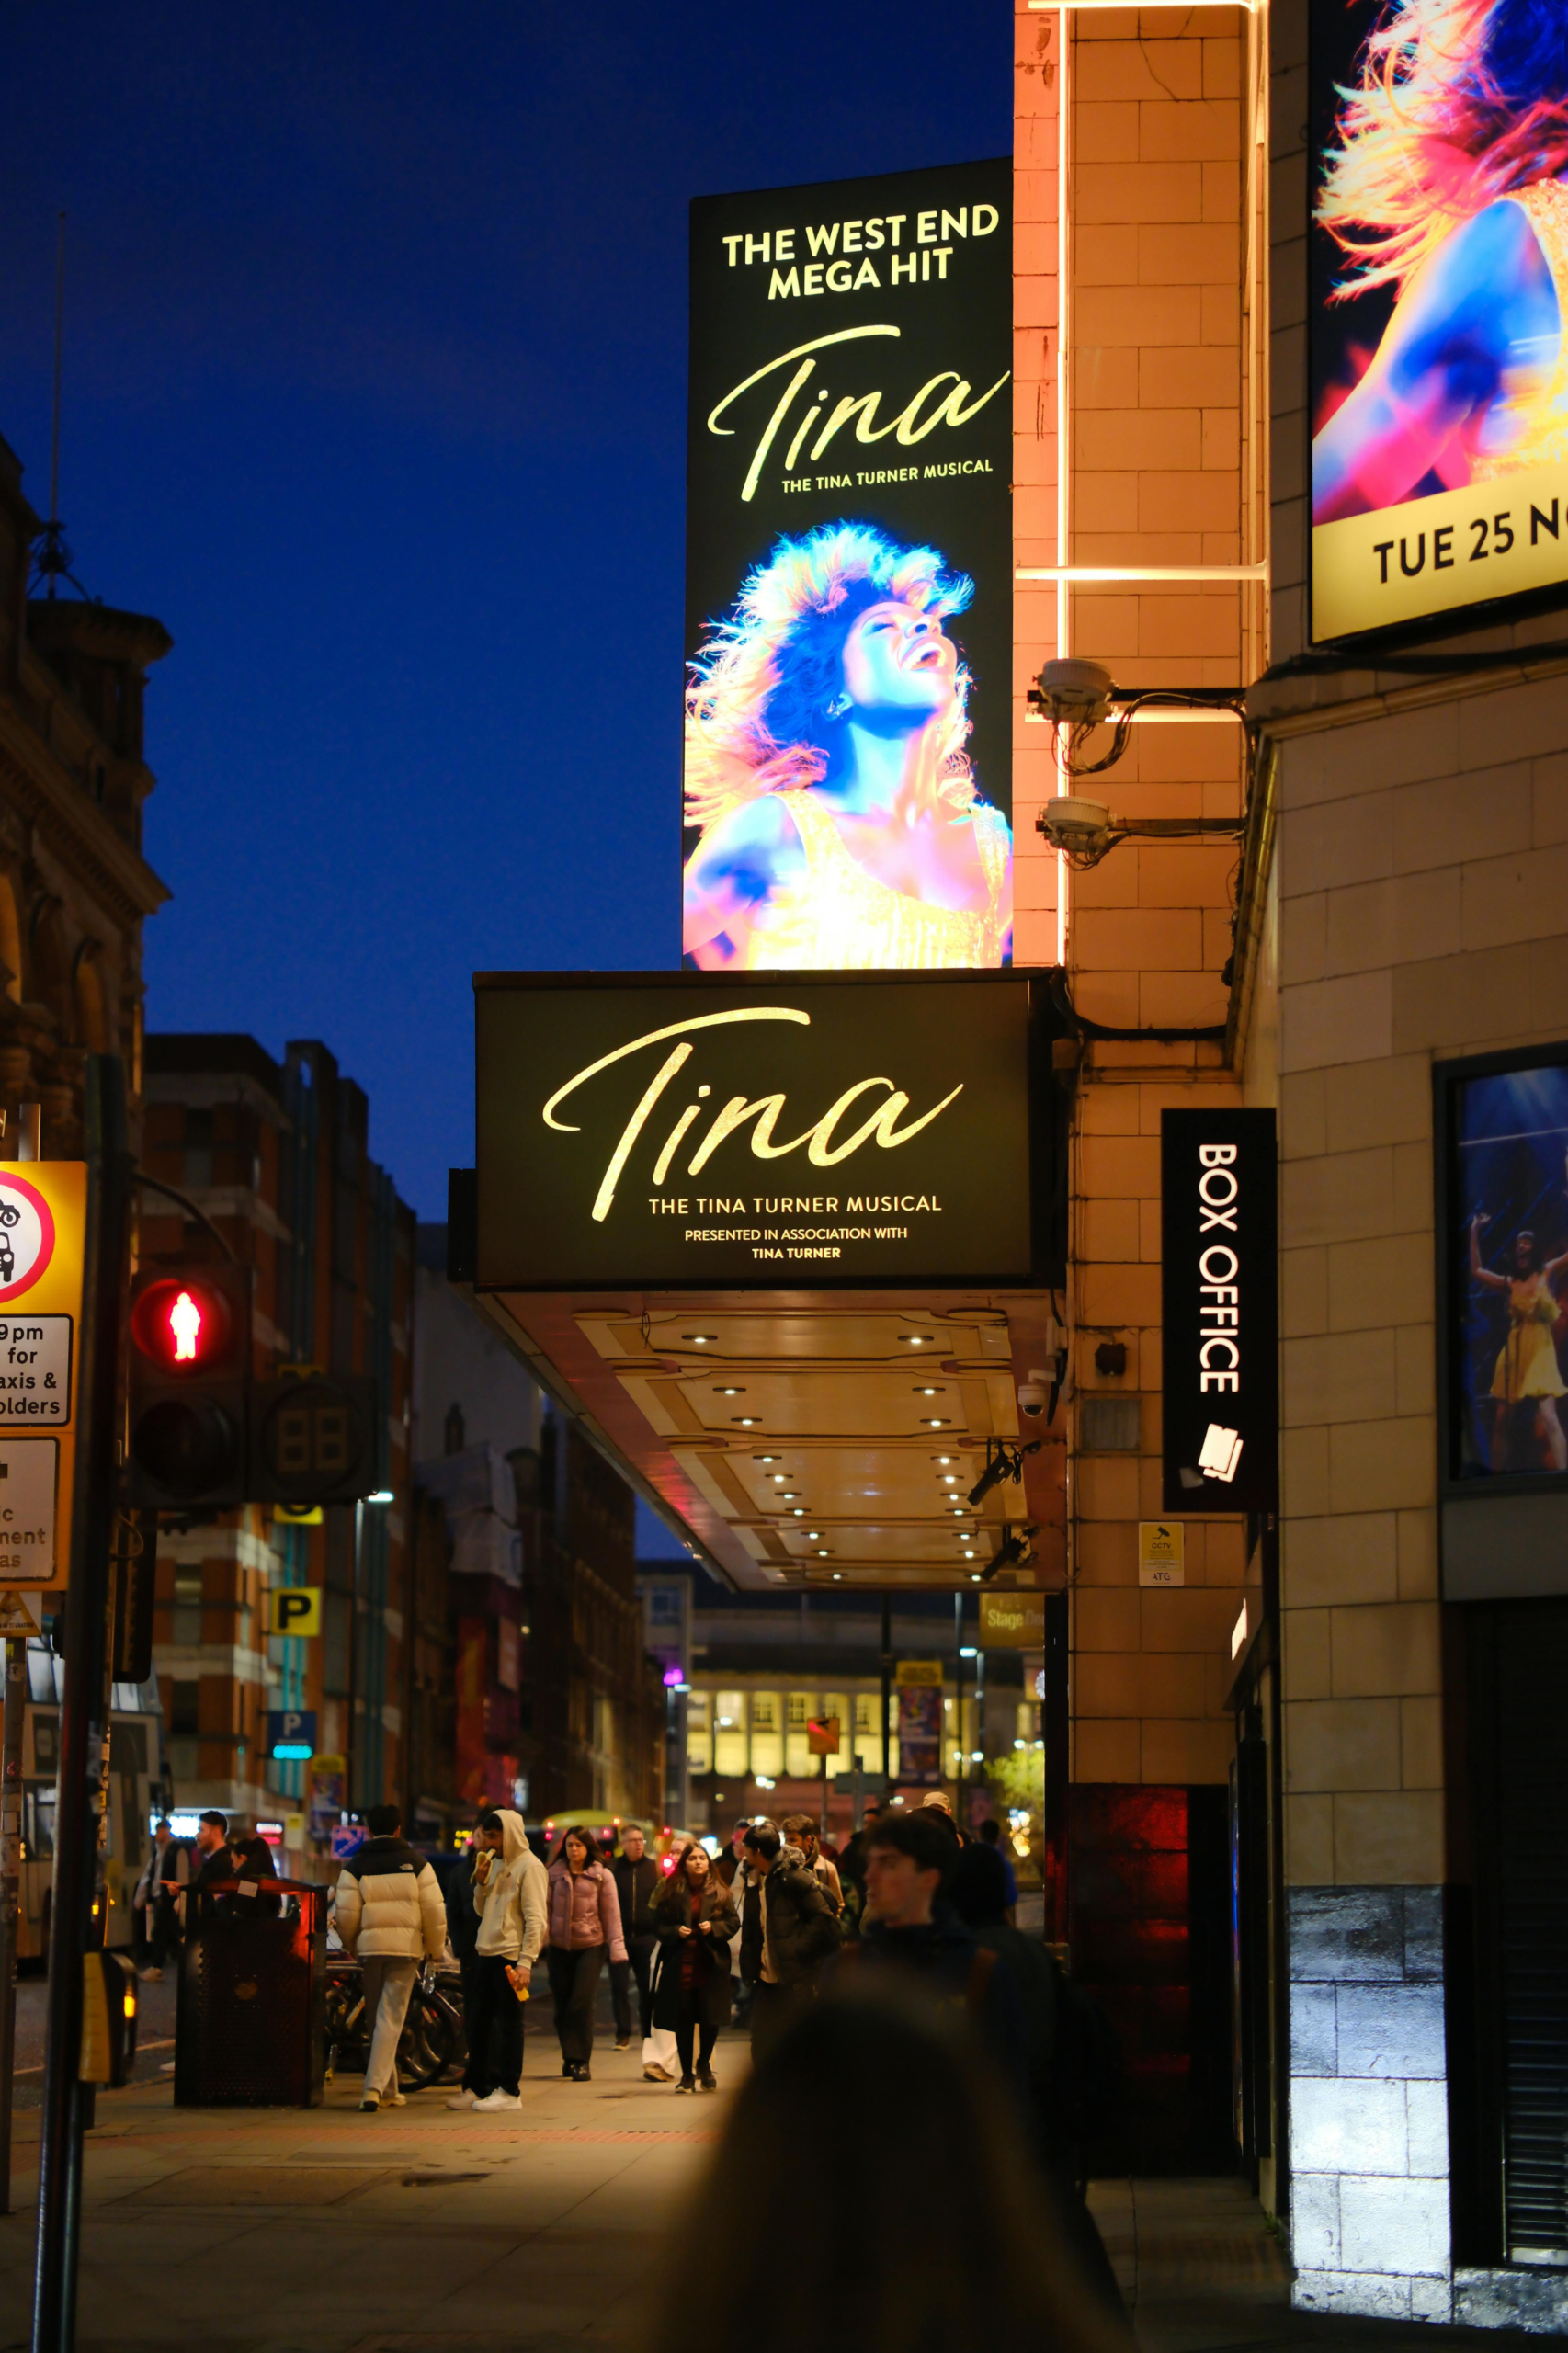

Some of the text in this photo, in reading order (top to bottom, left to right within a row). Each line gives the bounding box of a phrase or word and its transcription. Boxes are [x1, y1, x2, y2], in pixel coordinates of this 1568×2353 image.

[722, 203, 1000, 267] THE WEST END
[767, 246, 954, 301] MEGA HIT
[707, 324, 1011, 503] Tina
[781, 458, 994, 494] THE TINA TURNER MUSICAL
[1373, 497, 1568, 585] TUE 25 N
[541, 1006, 964, 1222] Tina
[648, 1194, 943, 1215] THE TINA TURNER MUSICAL
[685, 1226, 908, 1242] PRESENTED IN ASSOCIATION WITH
[751, 1245, 842, 1259] TINA TURNER
[1199, 1143, 1240, 1393] BOX OFFICE
[7, 1347, 38, 1364] for
[43, 1371, 57, 1390] &
[1153, 1572, 1171, 1581] ATG
[278, 1594, 312, 1630] P
[987, 1608, 1024, 1631] Stage
[282, 1712, 302, 1737] P
